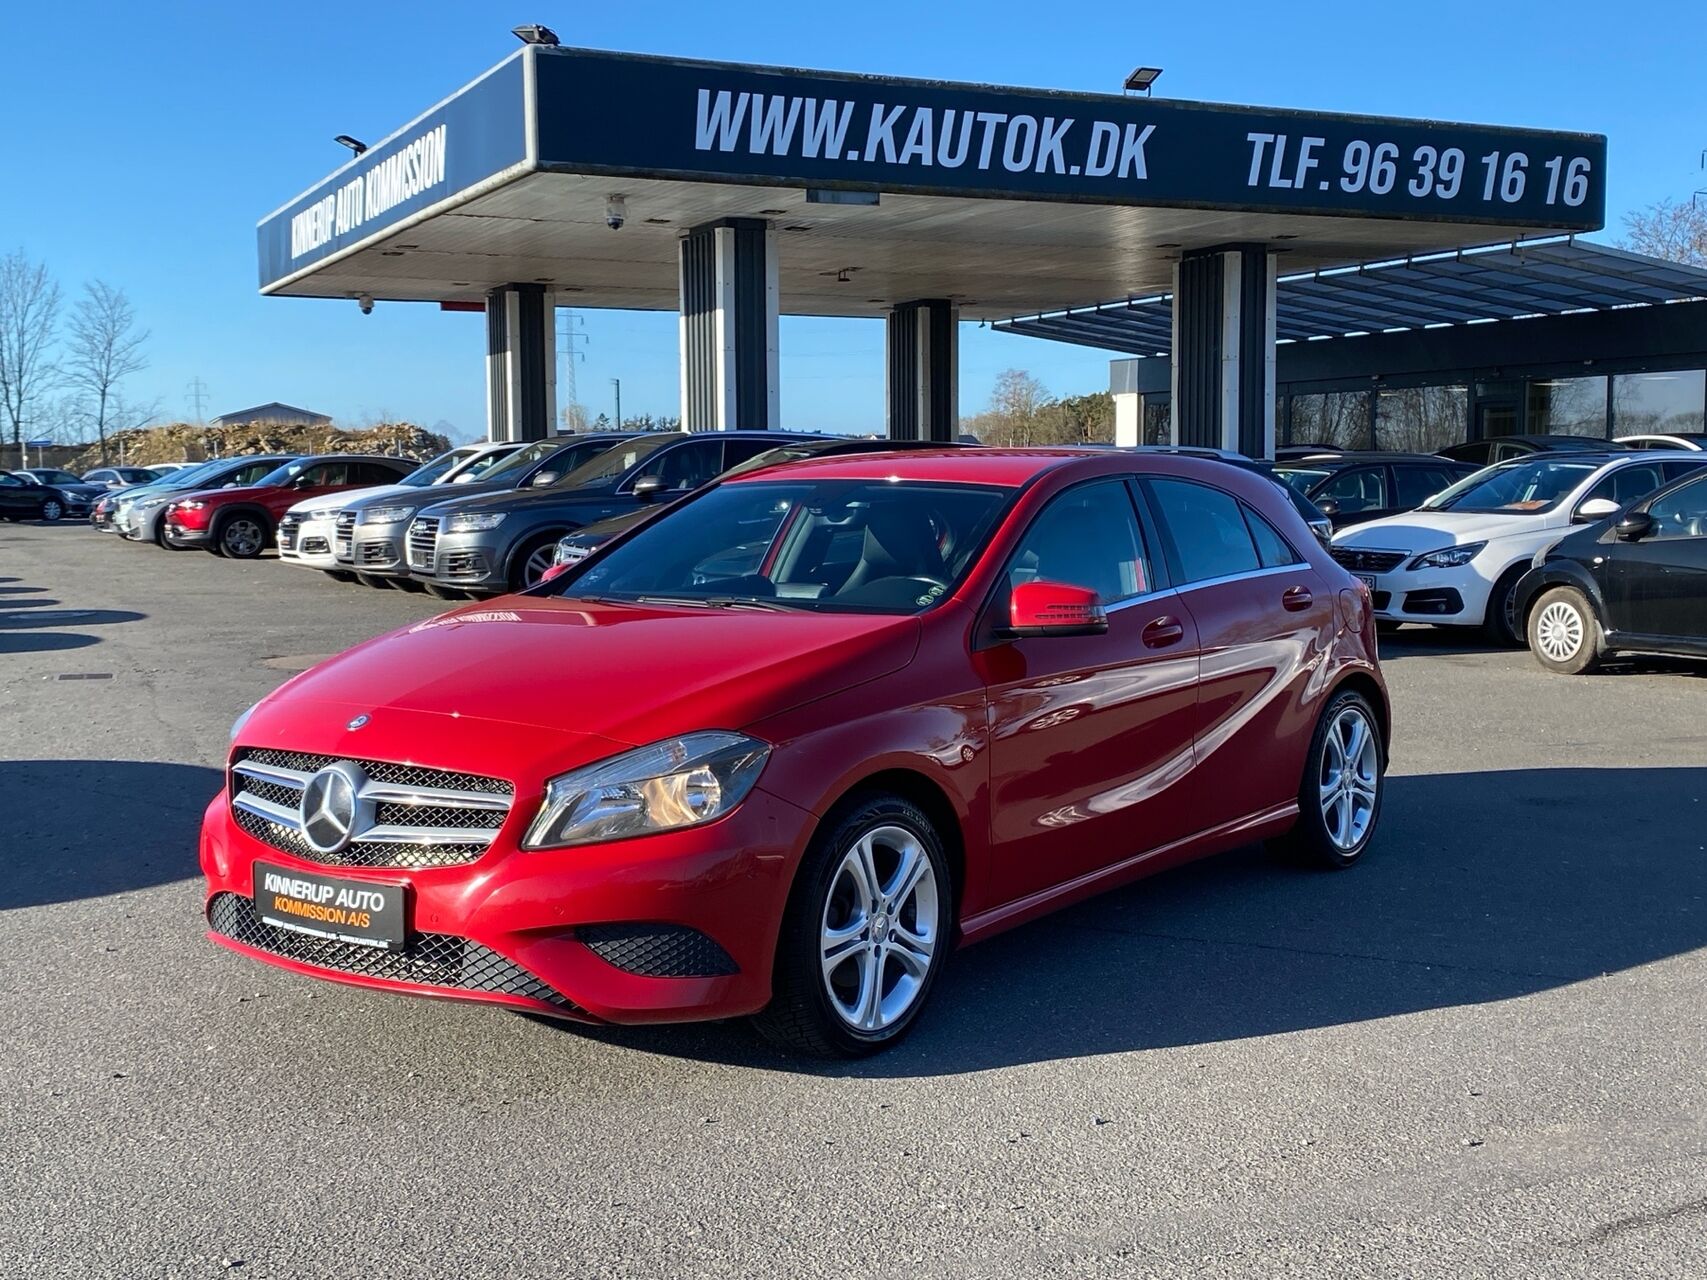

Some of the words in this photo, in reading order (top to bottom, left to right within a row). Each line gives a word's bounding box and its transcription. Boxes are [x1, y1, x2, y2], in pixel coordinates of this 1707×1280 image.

[694, 88, 1156, 179] WWW.KAUTOK.DK
[1247, 133, 1330, 191] TLF.
[1340, 140, 1399, 195] 96
[1408, 145, 1465, 200] 39
[1481, 151, 1529, 203] 16
[1544, 156, 1592, 207] 16
[291, 194, 336, 259] KINNERUP
[335, 176, 365, 237] AUTO
[365, 124, 447, 221] KOMMISSION
[264, 873, 334, 903] KINNERUP
[335, 888, 385, 913] AUTO
[274, 896, 346, 924] KOMMISSION
[348, 911, 371, 928] A/S
